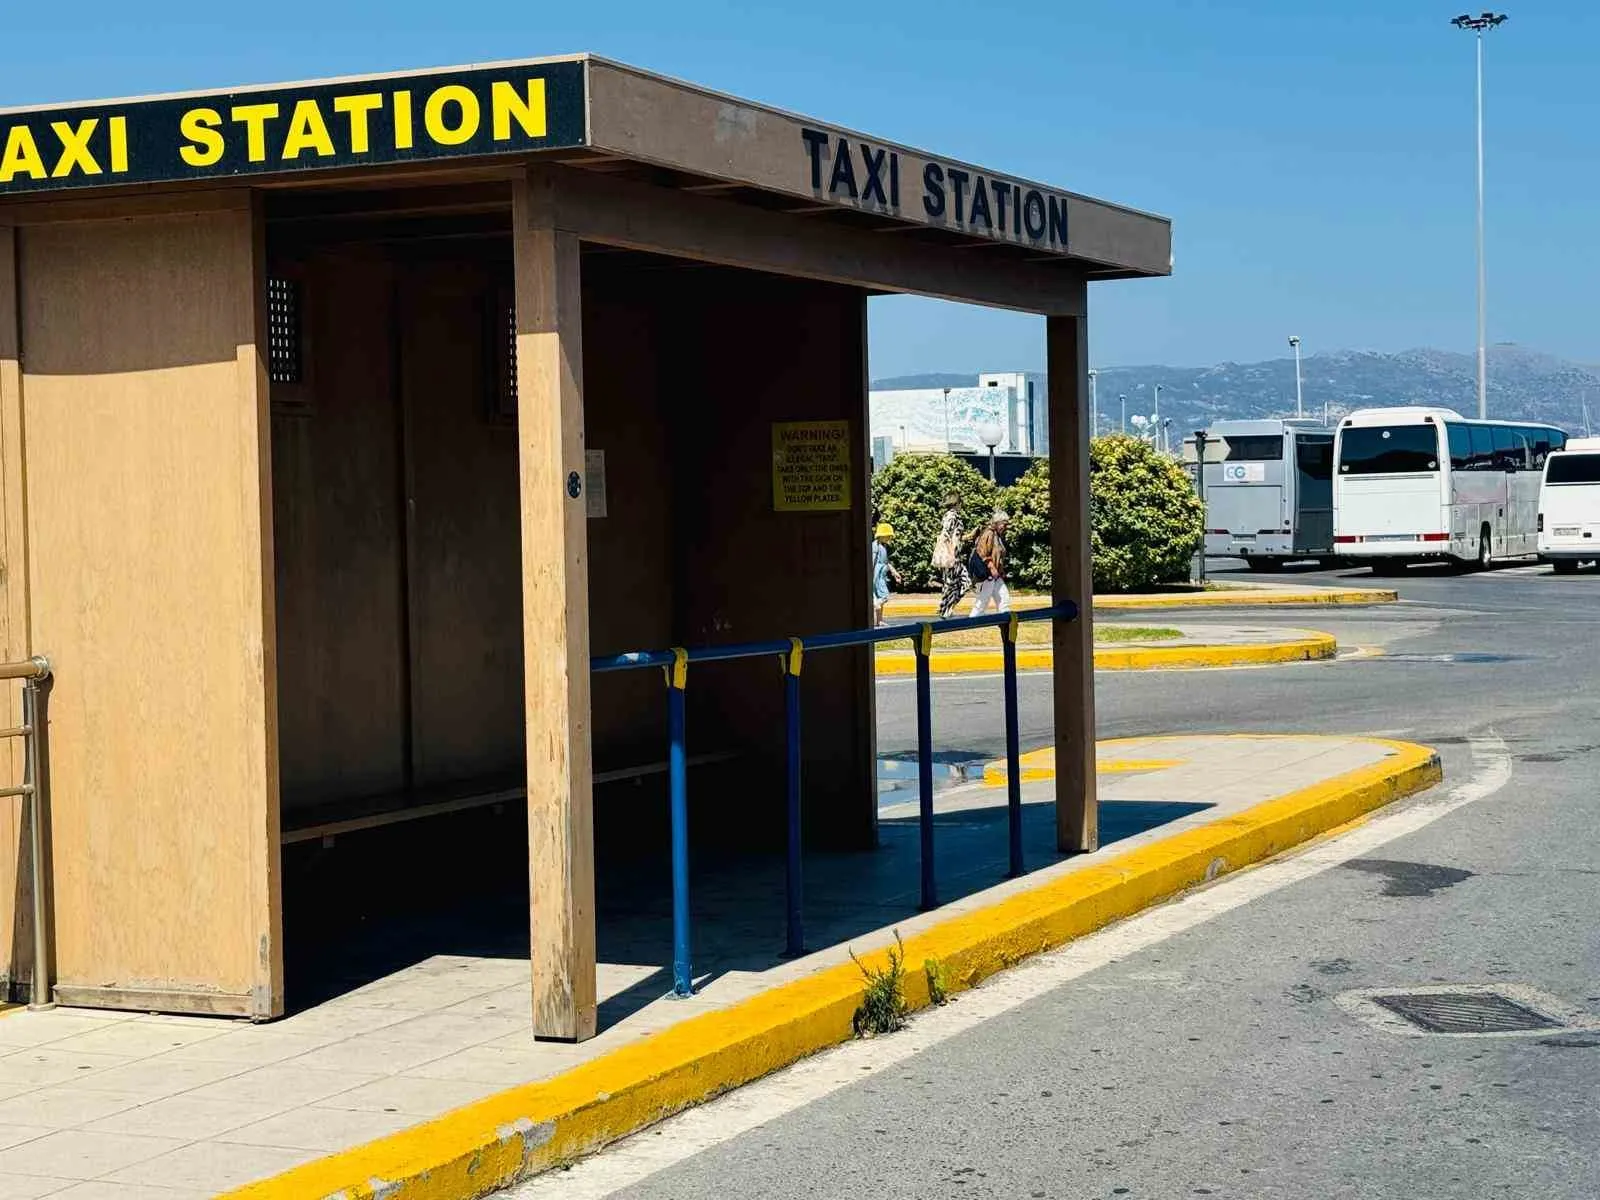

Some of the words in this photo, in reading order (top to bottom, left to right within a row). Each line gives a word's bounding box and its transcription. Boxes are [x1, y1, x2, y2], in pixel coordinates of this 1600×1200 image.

[179, 77, 548, 167] STATION
[802, 128, 900, 206] TAXI
[922, 162, 1068, 246] STATION
[780, 429, 846, 441] WARNING!
[784, 494, 813, 504] YELLOW
